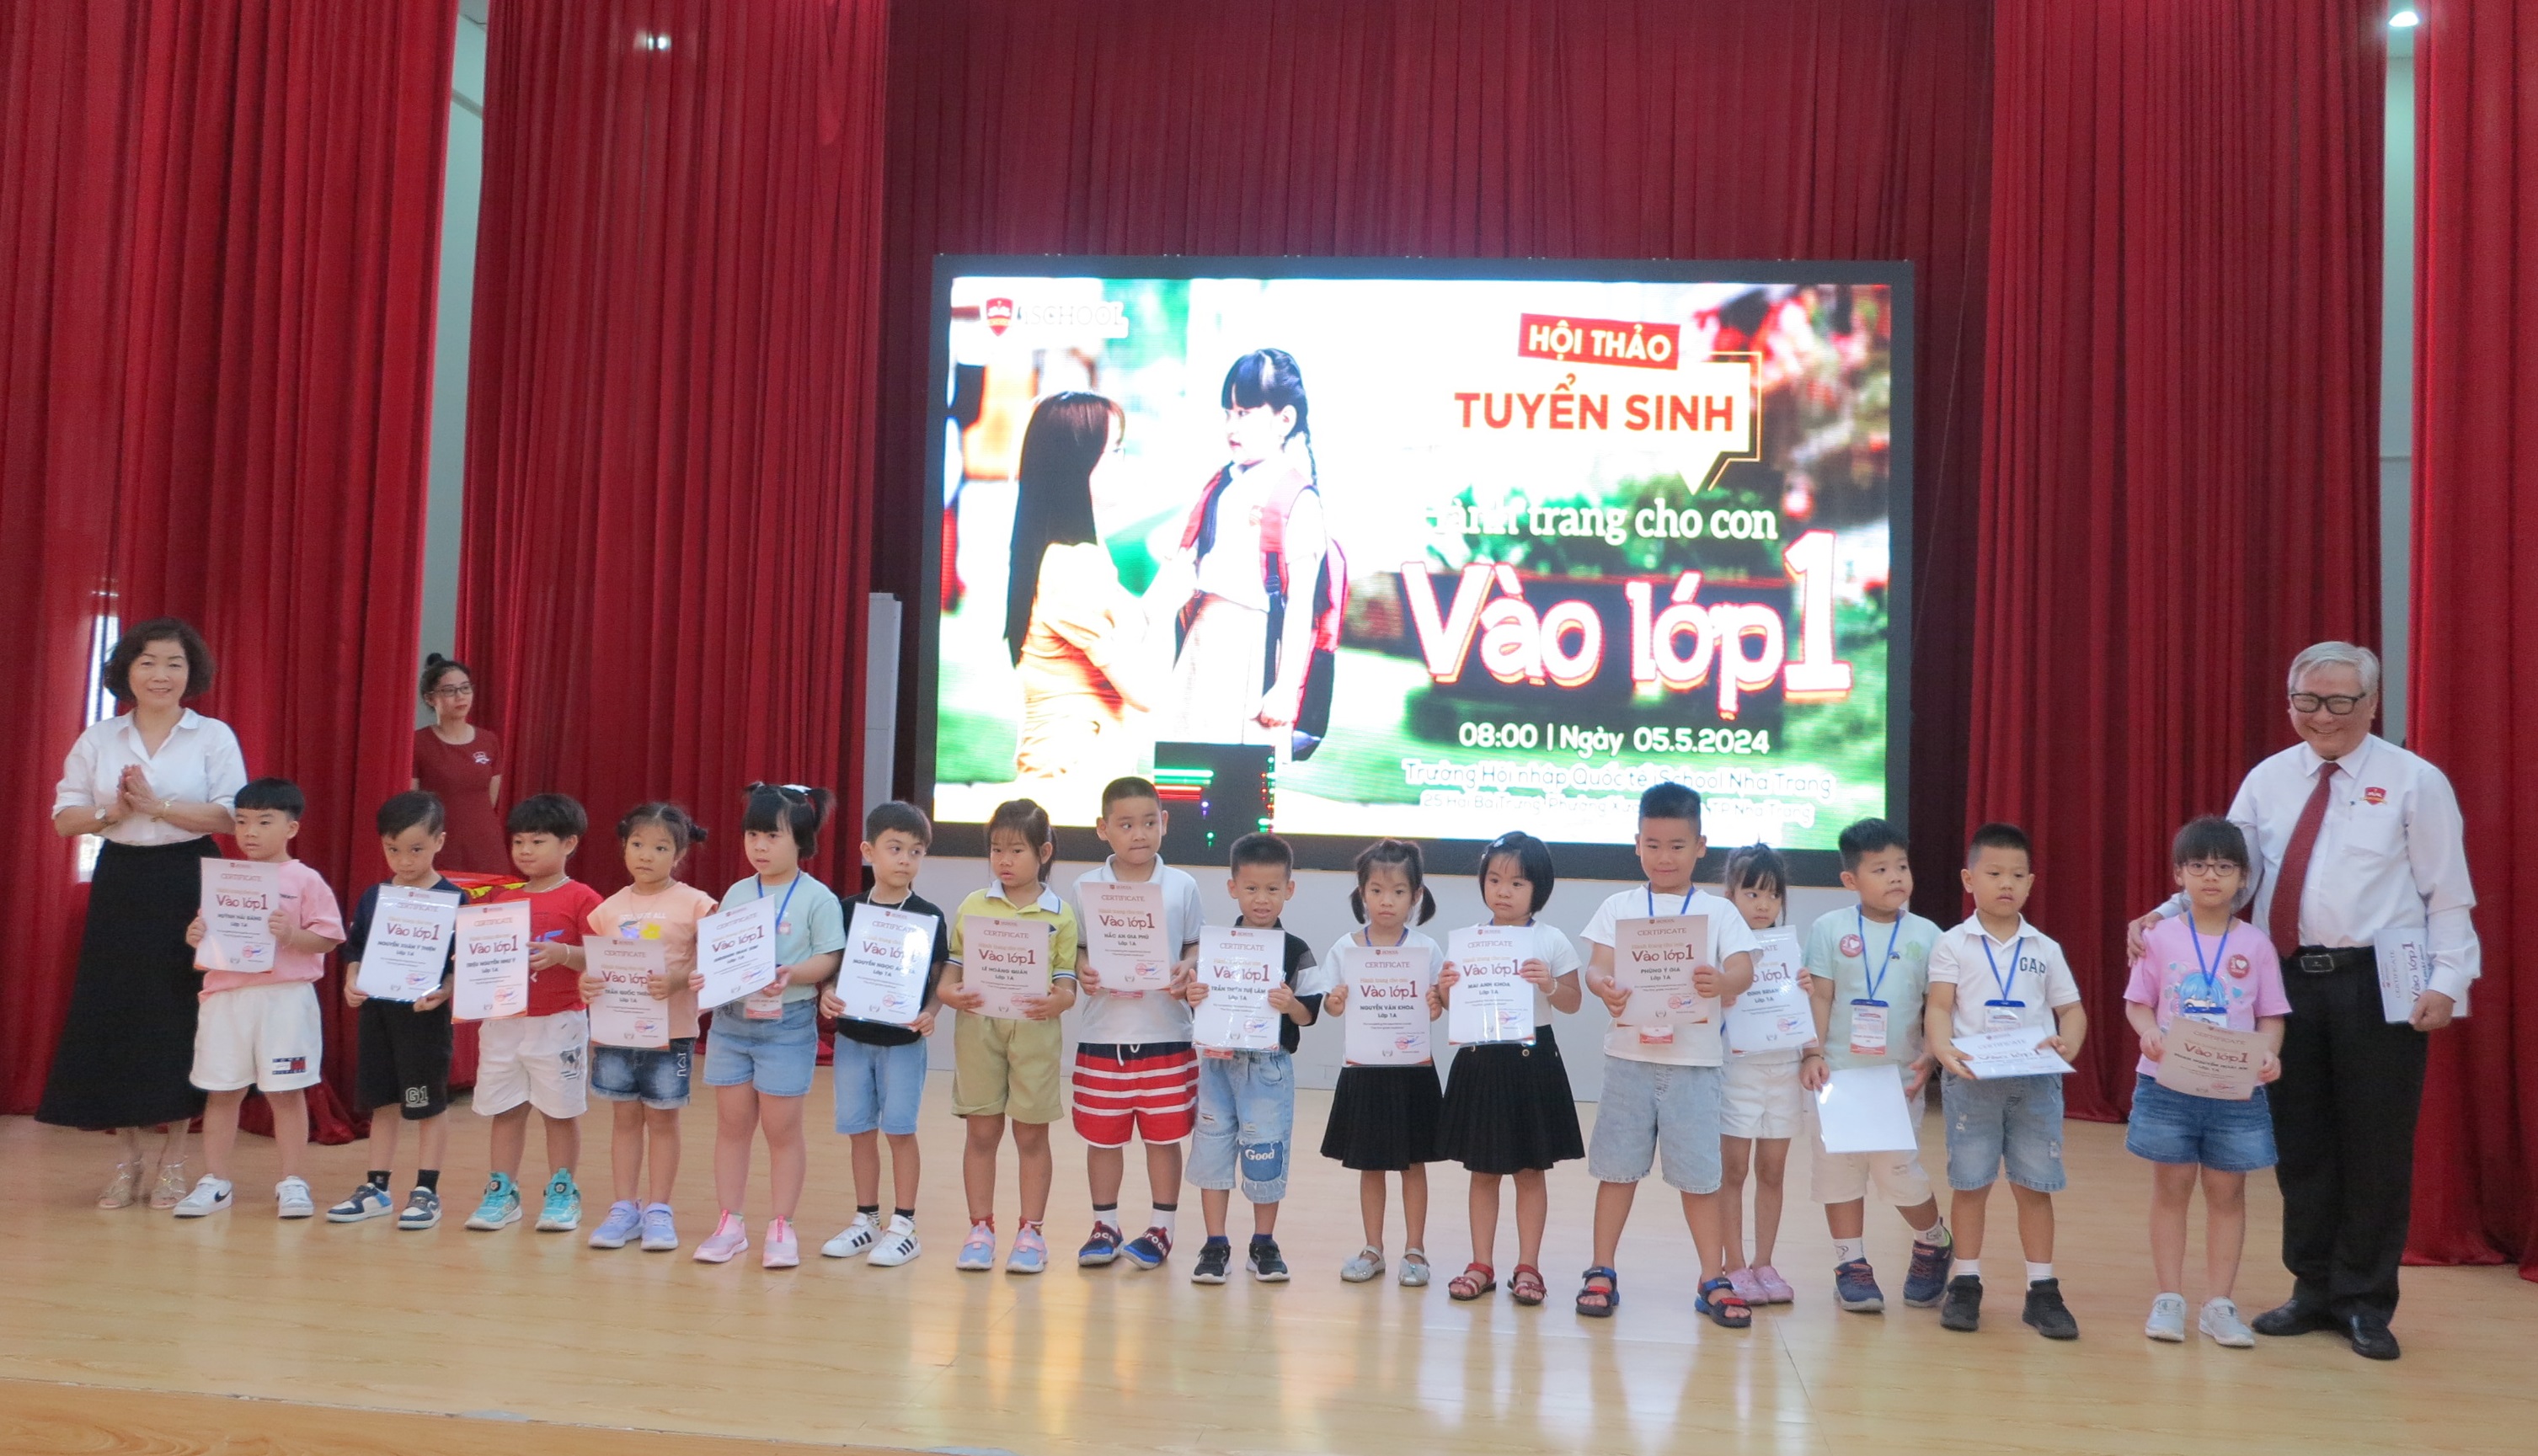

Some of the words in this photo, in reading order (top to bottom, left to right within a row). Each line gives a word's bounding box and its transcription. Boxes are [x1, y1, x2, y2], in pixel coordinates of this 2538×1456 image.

[1529, 319, 1583, 360] HỘI
[1591, 324, 1671, 361] THẢO
[1454, 373, 1608, 429] TUYỂN
[1625, 394, 1733, 431] SINH
[1527, 505, 1627, 546] trang
[1635, 498, 1703, 538] cho
[1710, 509, 1778, 539] con
[1401, 561, 1606, 689] Vào
[1626, 570, 1786, 721] lớp
[1783, 530, 1852, 701] 1
[1459, 722, 1538, 749] 08:00
[1560, 725, 1624, 759] Ngày
[1633, 727, 1770, 755] 05.5.2024
[1729, 772, 1769, 790] Nha
[1774, 772, 1831, 798] Trang
[216, 894, 239, 907] Vào
[387, 923, 409, 936] Vào
[1099, 915, 1124, 927] Vào
[1146, 913, 1155, 929] 1
[984, 930, 1029, 939] CERTIFICATE
[1637, 928, 1687, 936] CERTIFICATE
[469, 941, 490, 955] Vào
[863, 941, 886, 956] Vào
[979, 948, 1004, 963] Vào
[1028, 950, 1035, 964] 1
[1220, 943, 1264, 952] CERTIFICATE
[1632, 950, 1659, 963] Vào
[1686, 944, 1694, 960] 1
[1262, 964, 1269, 982] 1
[1462, 964, 1488, 977] Vào
[1512, 959, 1520, 975] 1
[2020, 957, 2046, 976] GAP
[602, 971, 626, 982] Vào
[1360, 985, 1387, 998] Vào
[1409, 980, 1418, 998] 1
[2183, 1043, 2212, 1058] Vào
[405, 1085, 428, 1104] G1
[1245, 1149, 1275, 1160] Good
